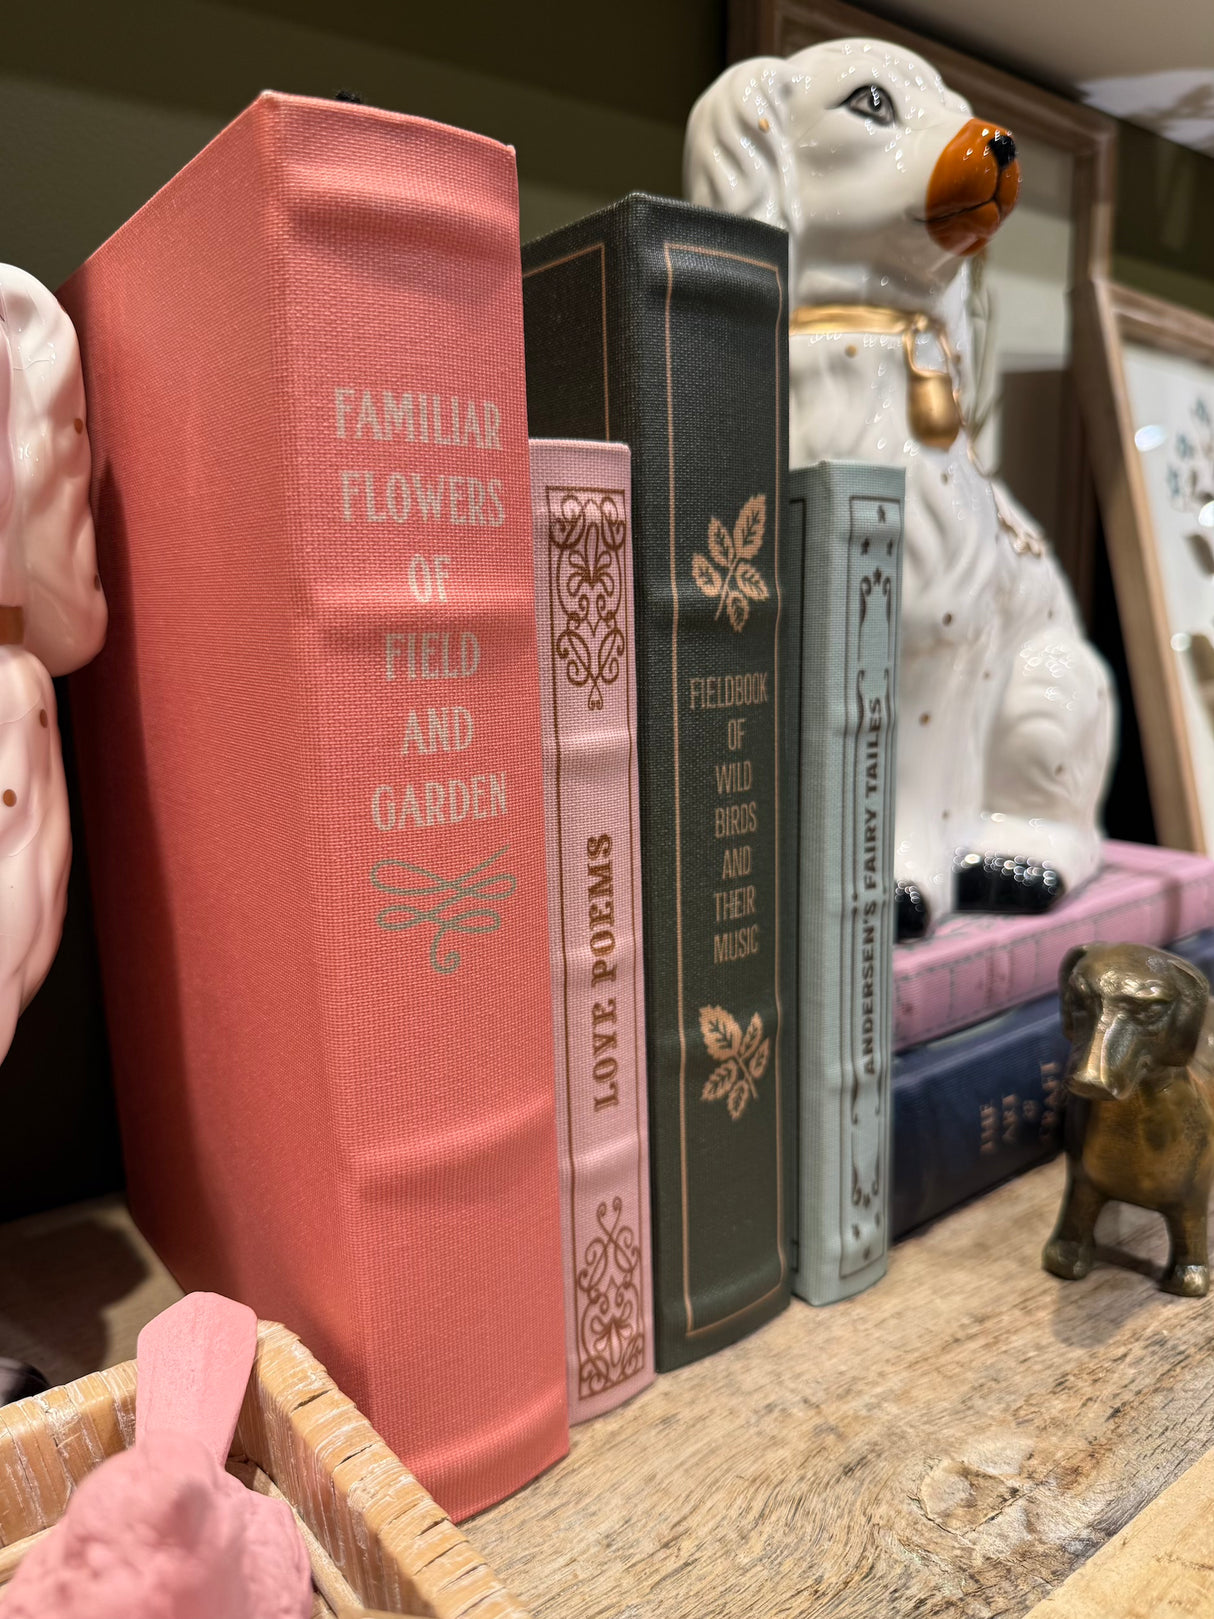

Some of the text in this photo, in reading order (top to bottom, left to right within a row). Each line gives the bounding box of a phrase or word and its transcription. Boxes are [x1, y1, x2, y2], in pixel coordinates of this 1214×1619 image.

[334, 388, 502, 451] FAMILIAR
[341, 471, 505, 527] FLOWERS
[408, 553, 451, 603] OF
[384, 632, 481, 680] FIELD
[690, 672, 768, 709] FIELDBOOK
[401, 706, 474, 755] AND
[728, 718, 746, 750] OF
[715, 761, 752, 794] WILD
[371, 774, 508, 831] GARDEN
[715, 802, 757, 838] BIRDS
[722, 846, 751, 880] AND
[860, 697, 882, 1074] ANDERSEN'S FAIRY TAILES
[714, 886, 756, 922] THEIR
[714, 924, 758, 963] MUSIC
[587, 833, 618, 1112] LOVE POEMS
